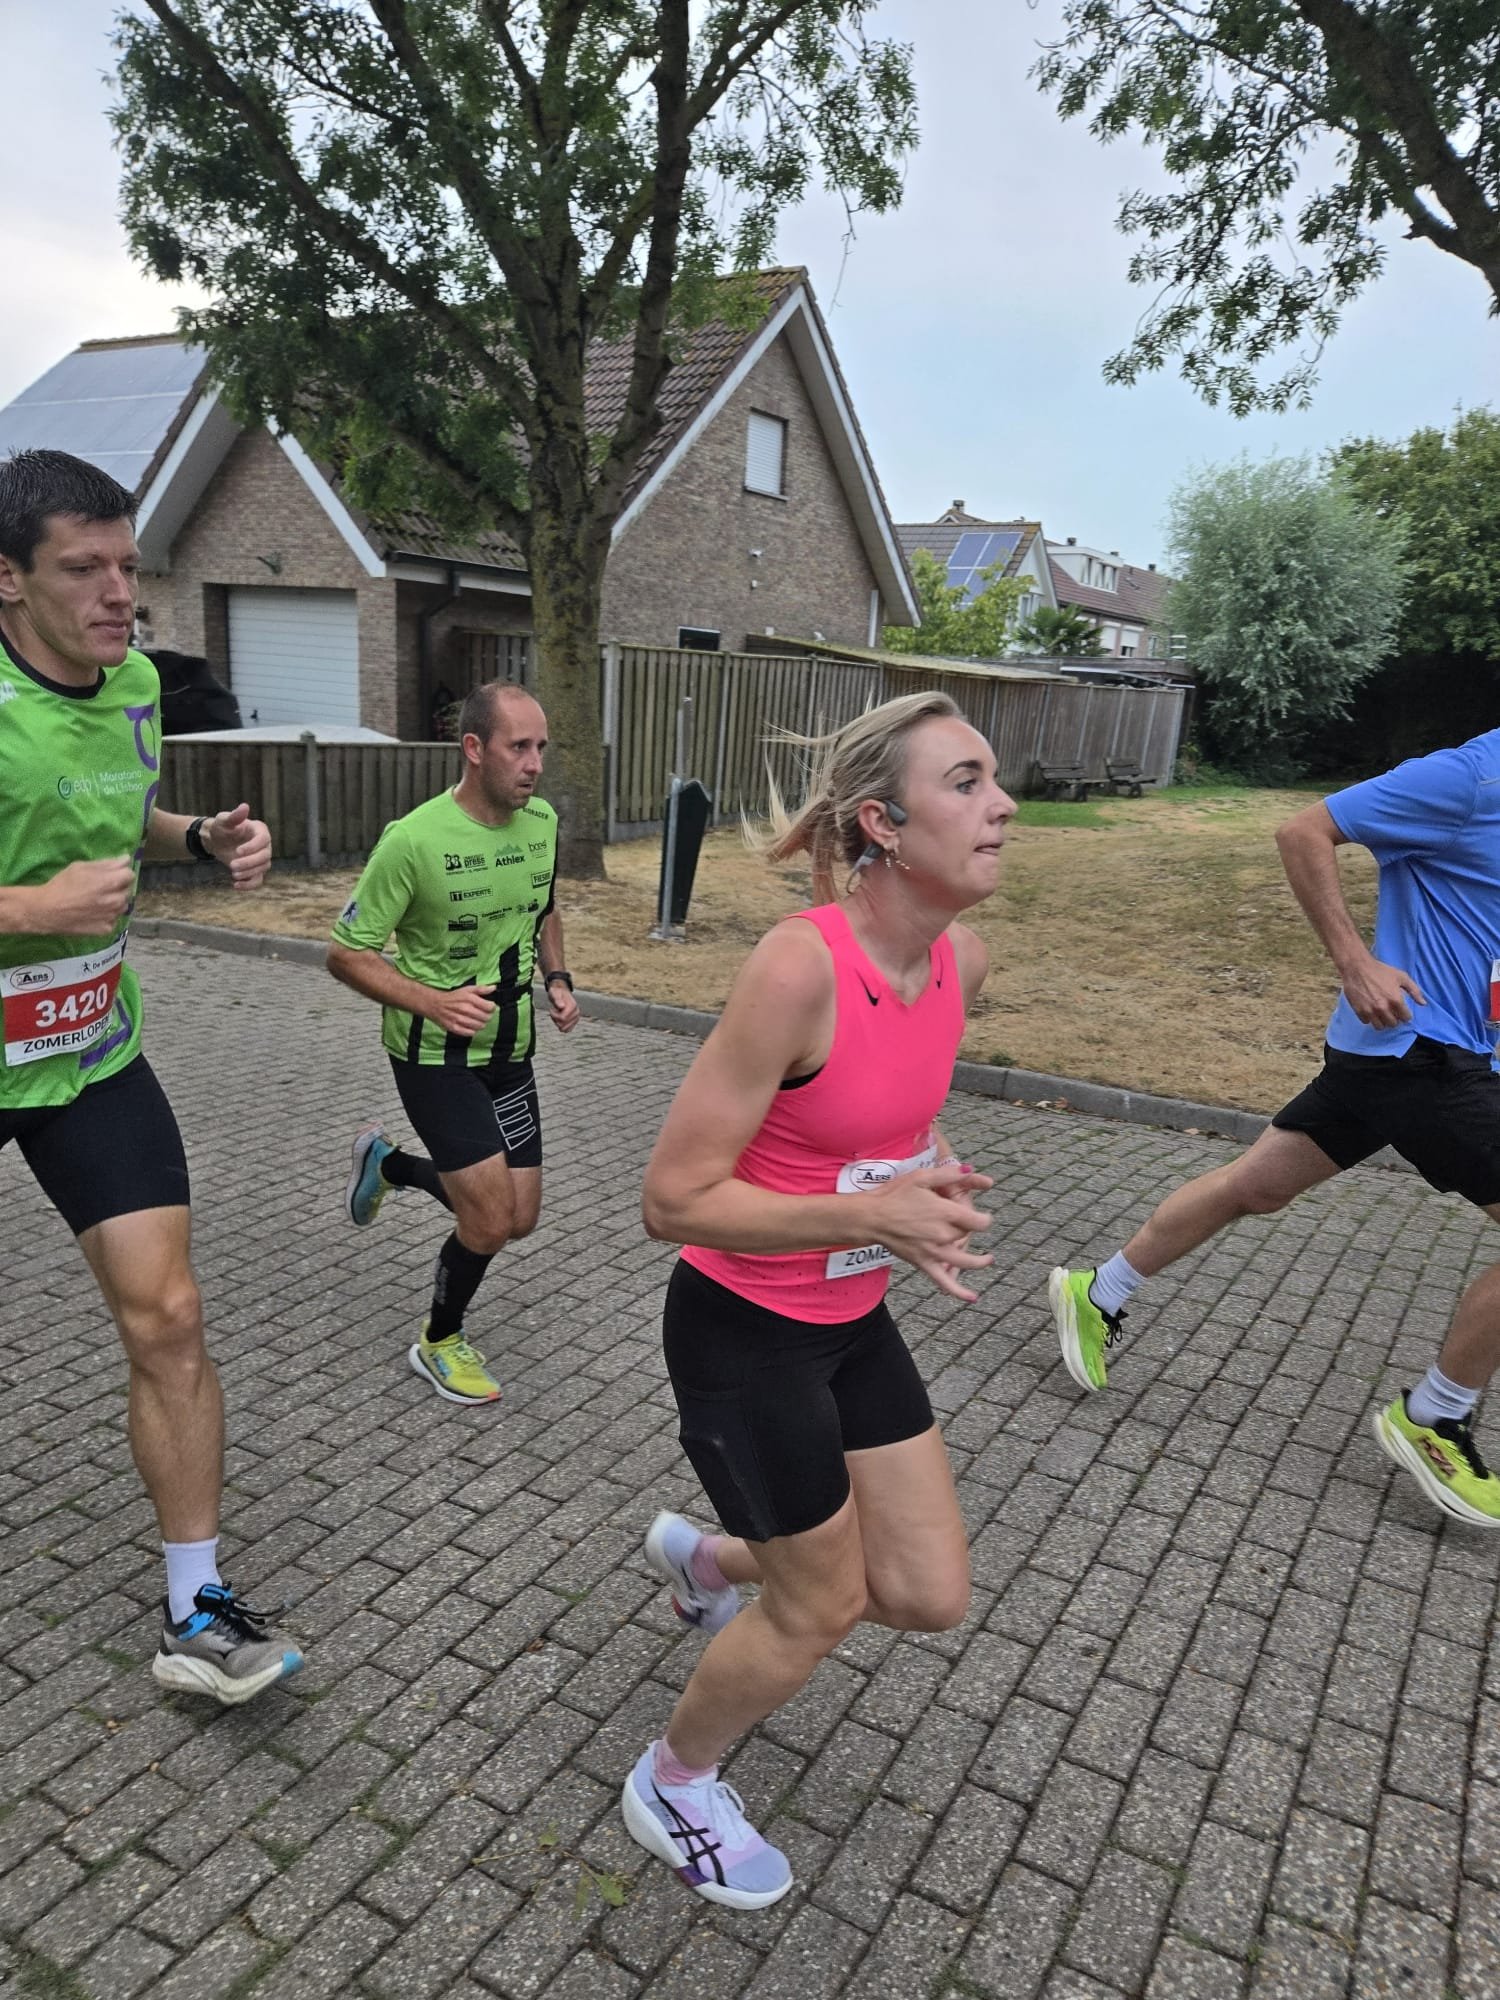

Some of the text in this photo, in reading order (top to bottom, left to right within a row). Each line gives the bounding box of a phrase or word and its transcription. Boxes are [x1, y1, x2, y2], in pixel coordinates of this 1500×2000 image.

[495, 854, 525, 867] Athlex
[35, 983, 108, 1028] 3420
[845, 1247, 890, 1266] ZOME
